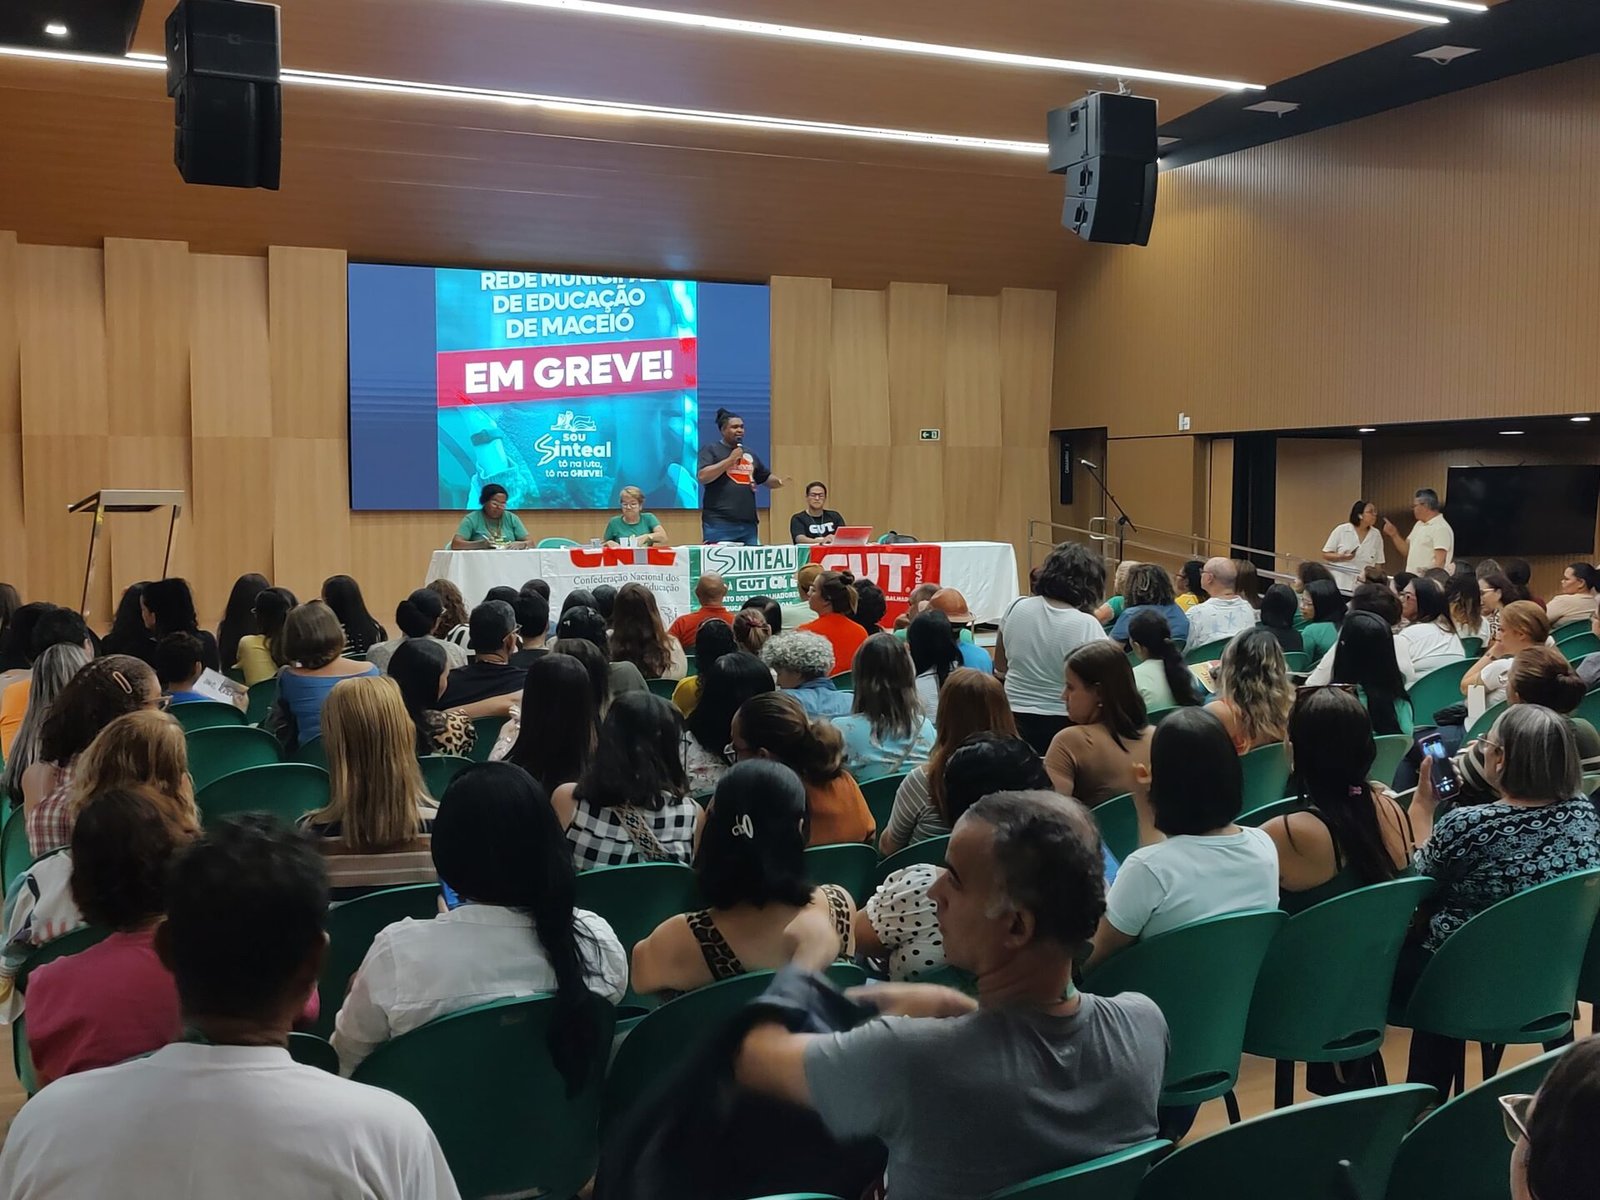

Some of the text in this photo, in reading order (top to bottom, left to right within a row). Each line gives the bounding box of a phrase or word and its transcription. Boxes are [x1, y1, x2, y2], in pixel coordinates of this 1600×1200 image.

[480, 272, 657, 291] REDE MUNIC
[493, 284, 646, 314] DE EDUCAÇÃO
[506, 307, 635, 339] DE MACEIÓ
[465, 350, 674, 394] EM GREVE!
[534, 433, 612, 467] Sinteal
[558, 460, 568, 468] tô
[583, 460, 603, 469] luta,
[545, 469, 604, 478] tô na GREVE!
[809, 522, 835, 534] CUT
[573, 573, 680, 585] Confederação Nacional dos
[739, 579, 764, 589] CUT
